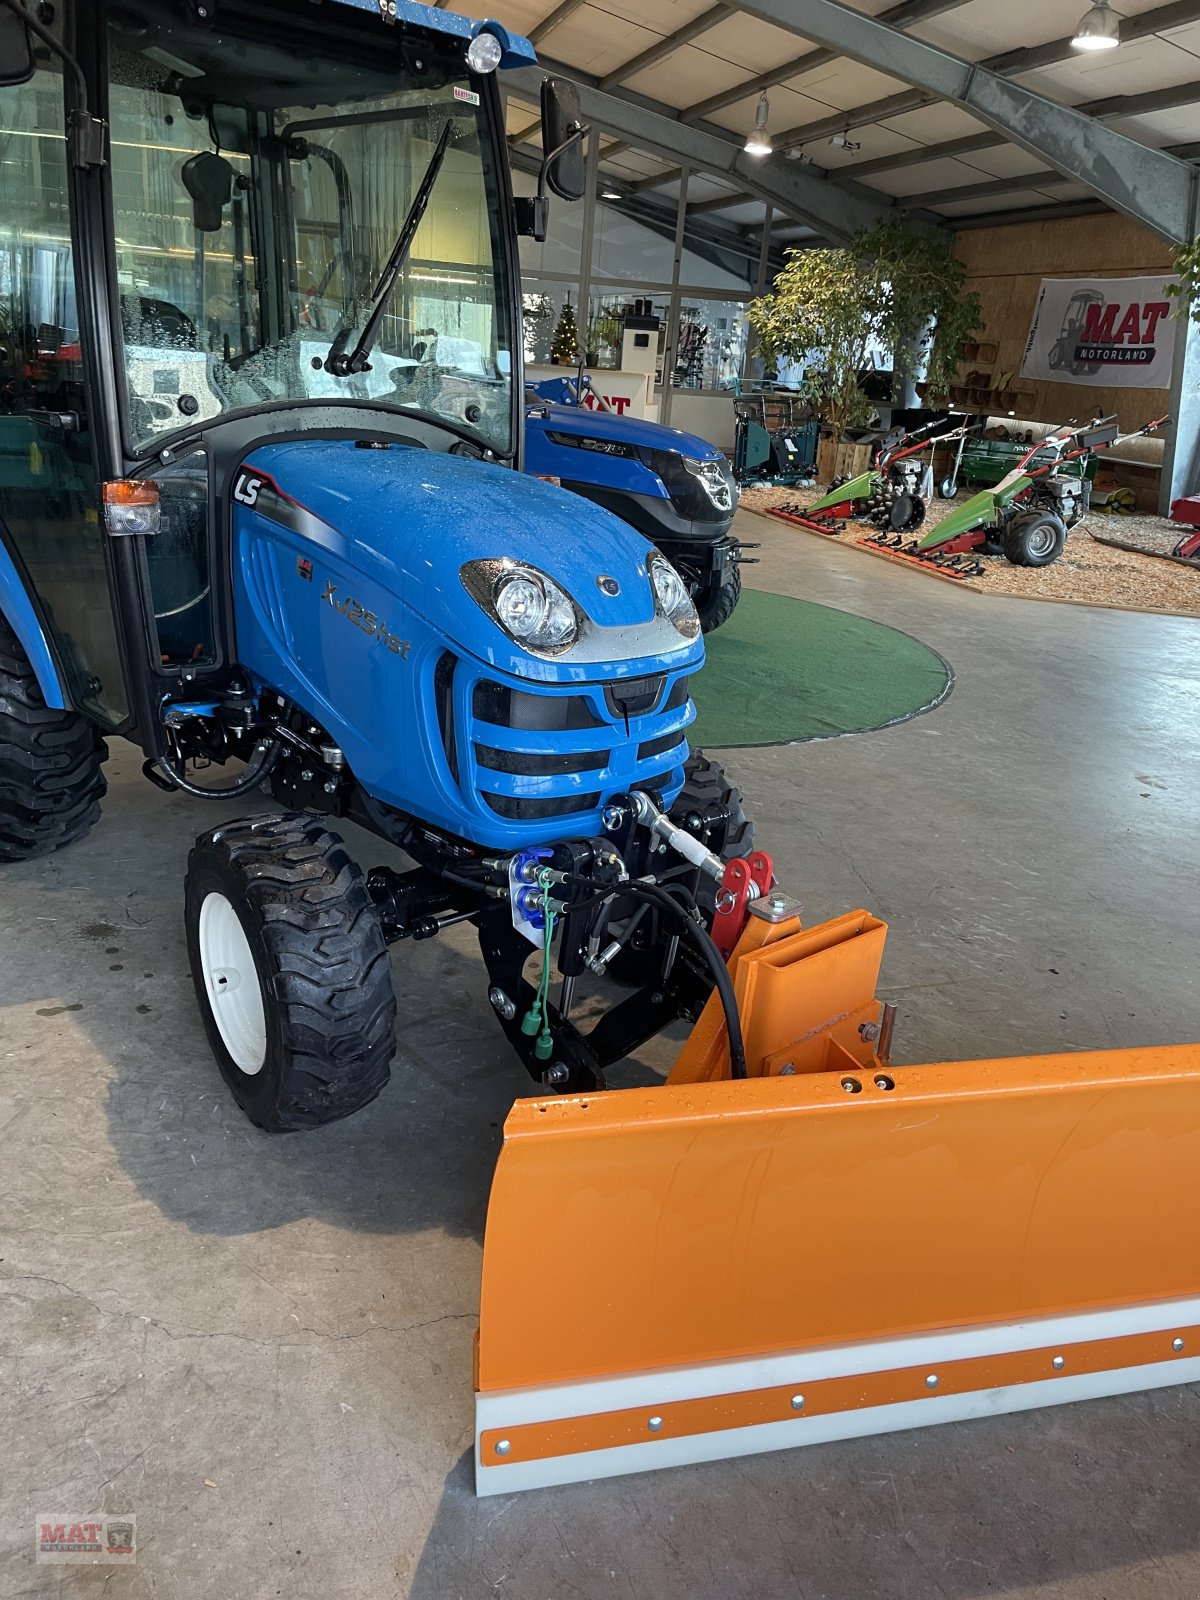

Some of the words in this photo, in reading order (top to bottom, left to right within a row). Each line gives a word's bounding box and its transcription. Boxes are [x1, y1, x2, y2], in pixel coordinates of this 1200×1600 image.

[1080, 302, 1171, 344] MAT
[1080, 349, 1147, 360] MOTORLAND
[234, 474, 262, 505] LS
